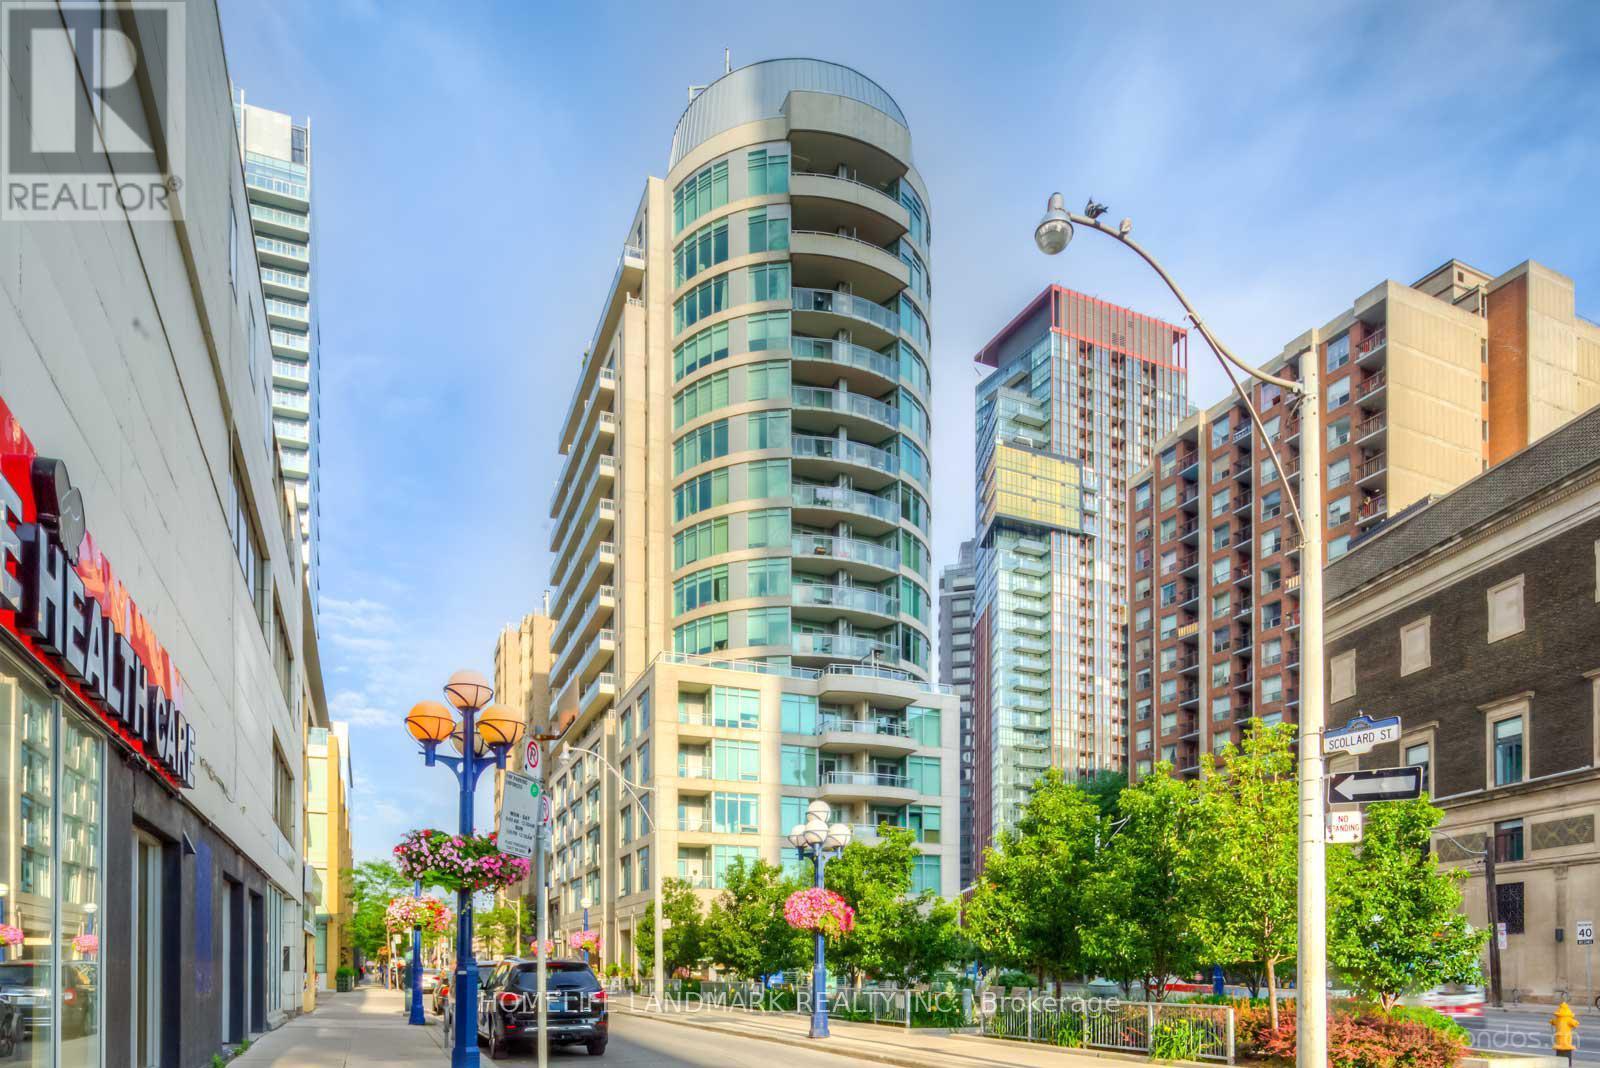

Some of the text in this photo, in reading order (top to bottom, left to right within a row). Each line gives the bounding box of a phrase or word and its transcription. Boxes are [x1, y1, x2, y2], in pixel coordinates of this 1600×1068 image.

[36, 524, 149, 743] HEALTH
[153, 686, 196, 789] CARE
[1329, 729, 1392, 750] SCOLLARD ST
[1327, 824, 1360, 833] STANDING
[1578, 928, 1592, 937] 40
